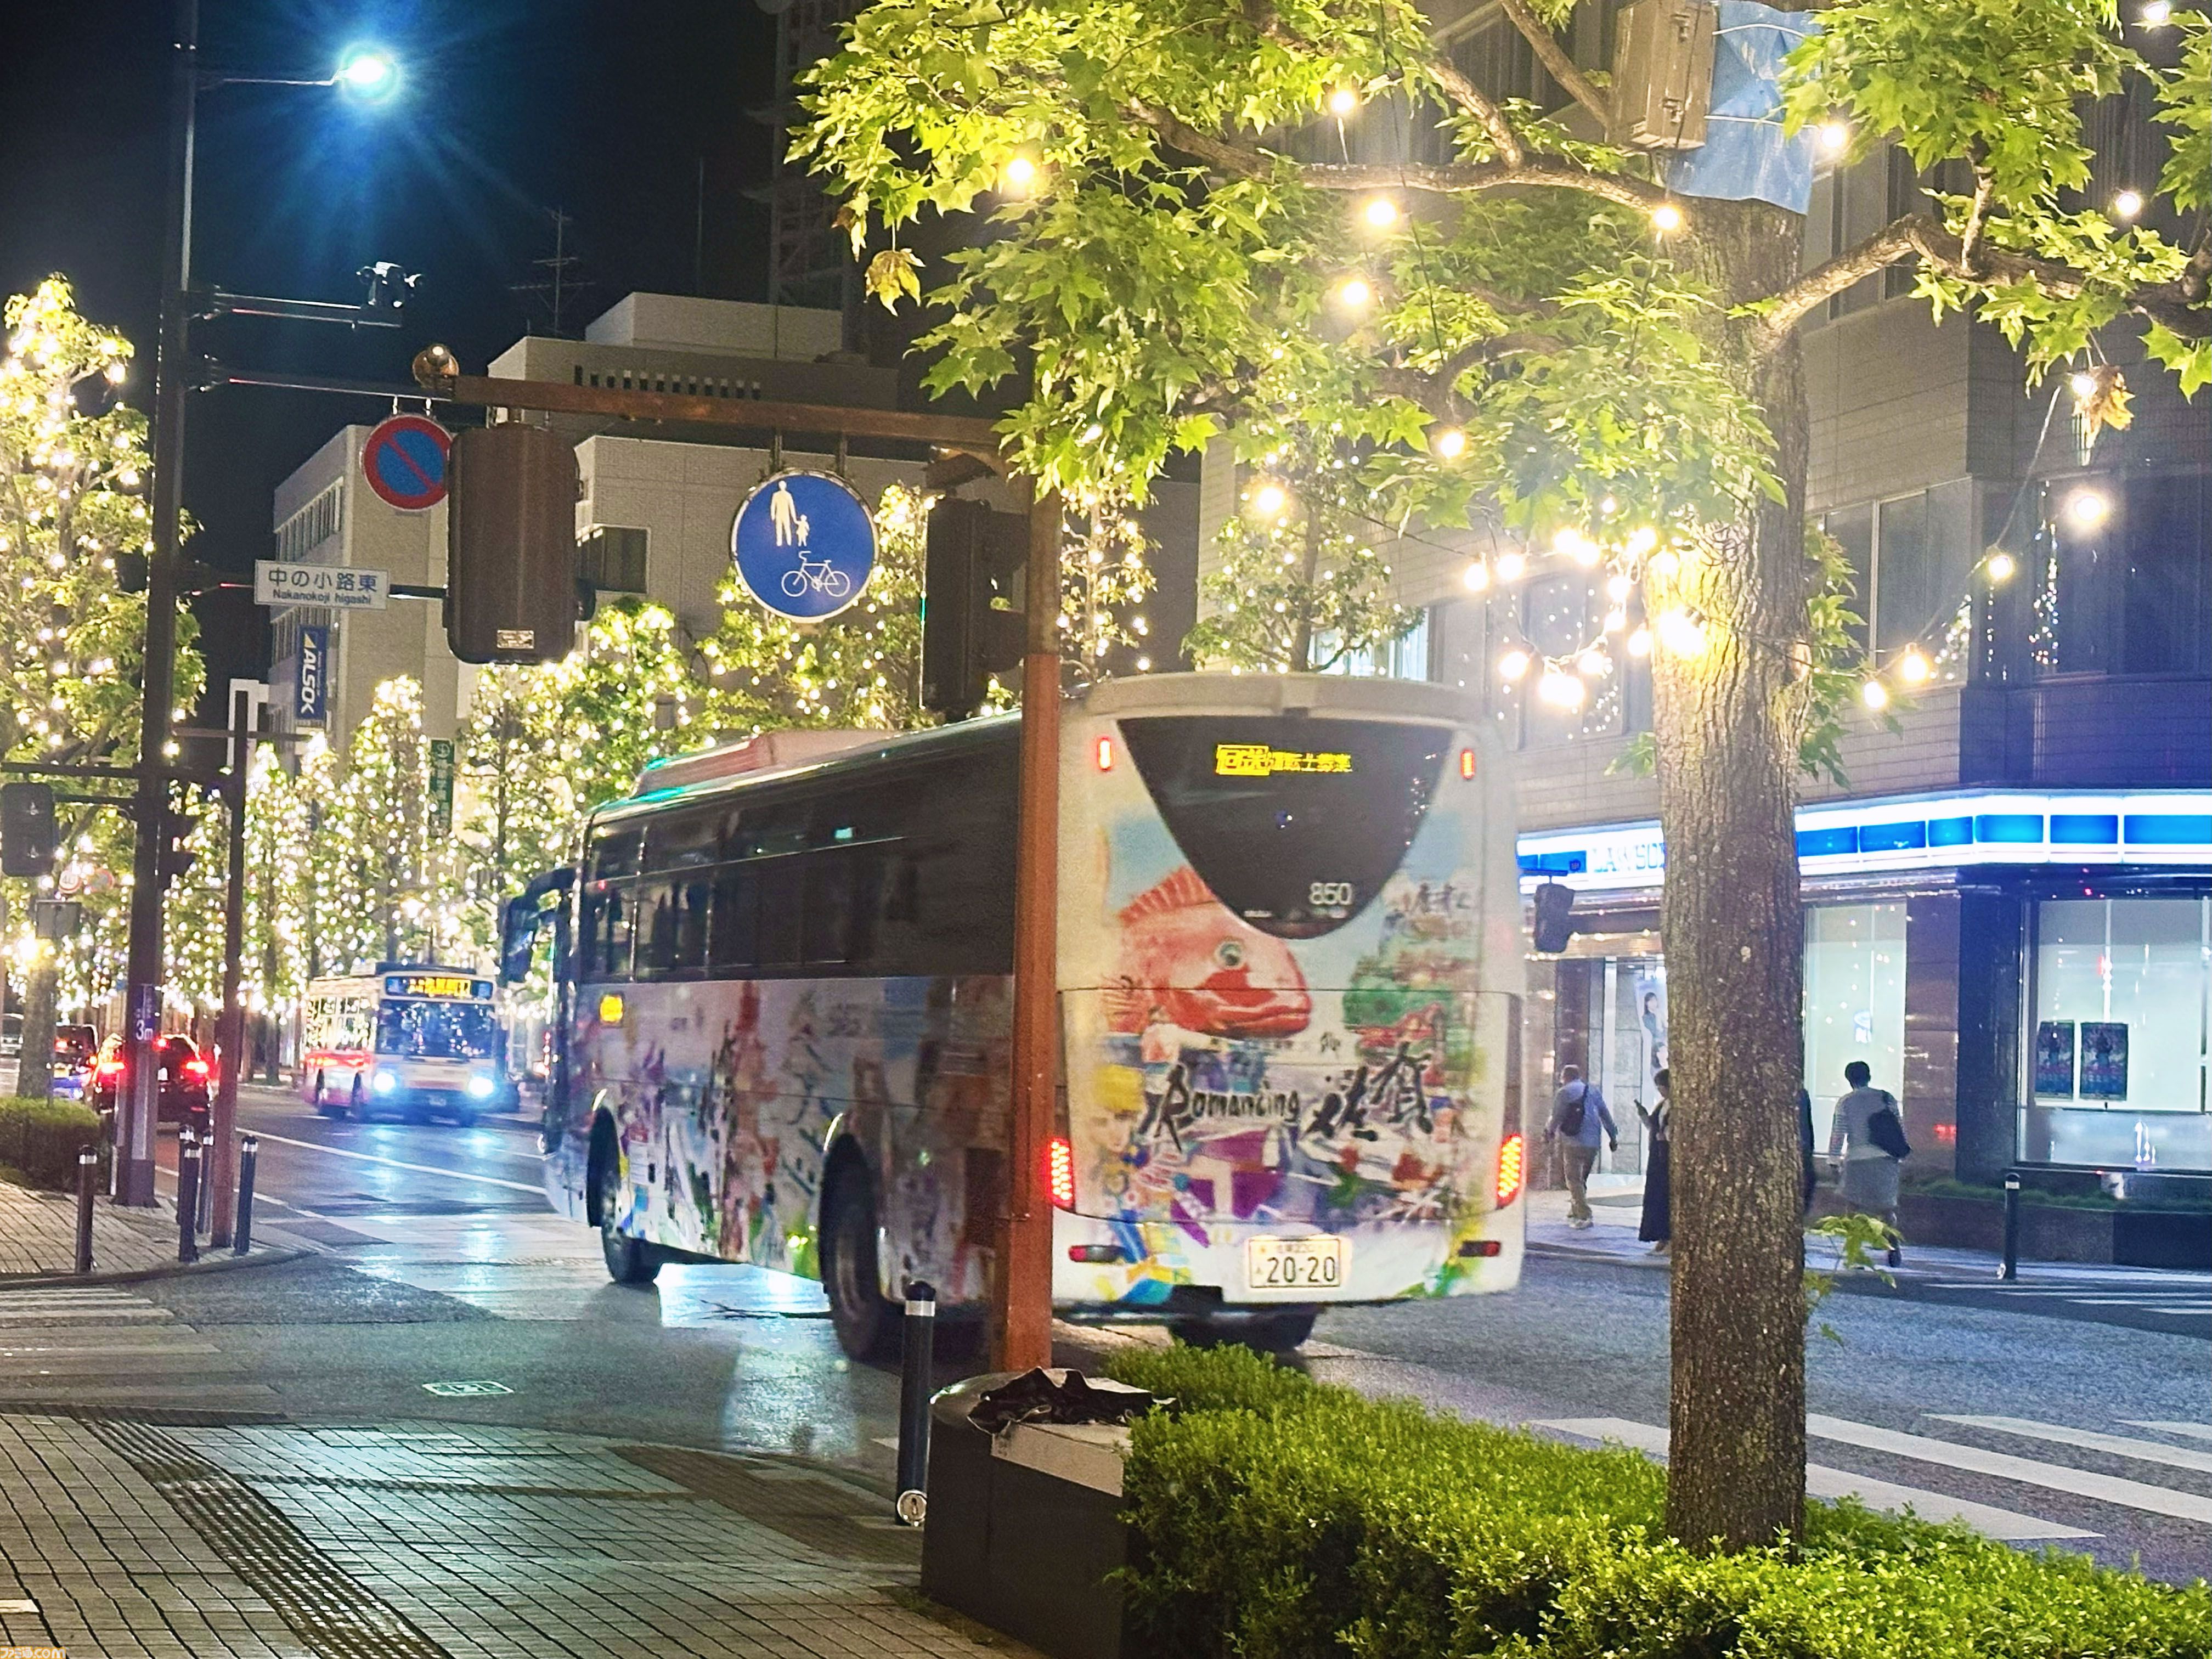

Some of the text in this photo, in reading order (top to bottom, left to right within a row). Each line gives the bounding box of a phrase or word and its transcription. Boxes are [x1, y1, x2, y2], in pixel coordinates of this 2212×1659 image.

[269, 568, 377, 592] 中の小路東
[273, 589, 371, 605] Nakanokoji higashi
[301, 648, 317, 714] ALSOK
[1309, 882, 1353, 905] 850
[136, 1019, 153, 1041] 3m
[1152, 1064, 1299, 1152] Romancing
[1267, 1256, 1335, 1283] 20-20
